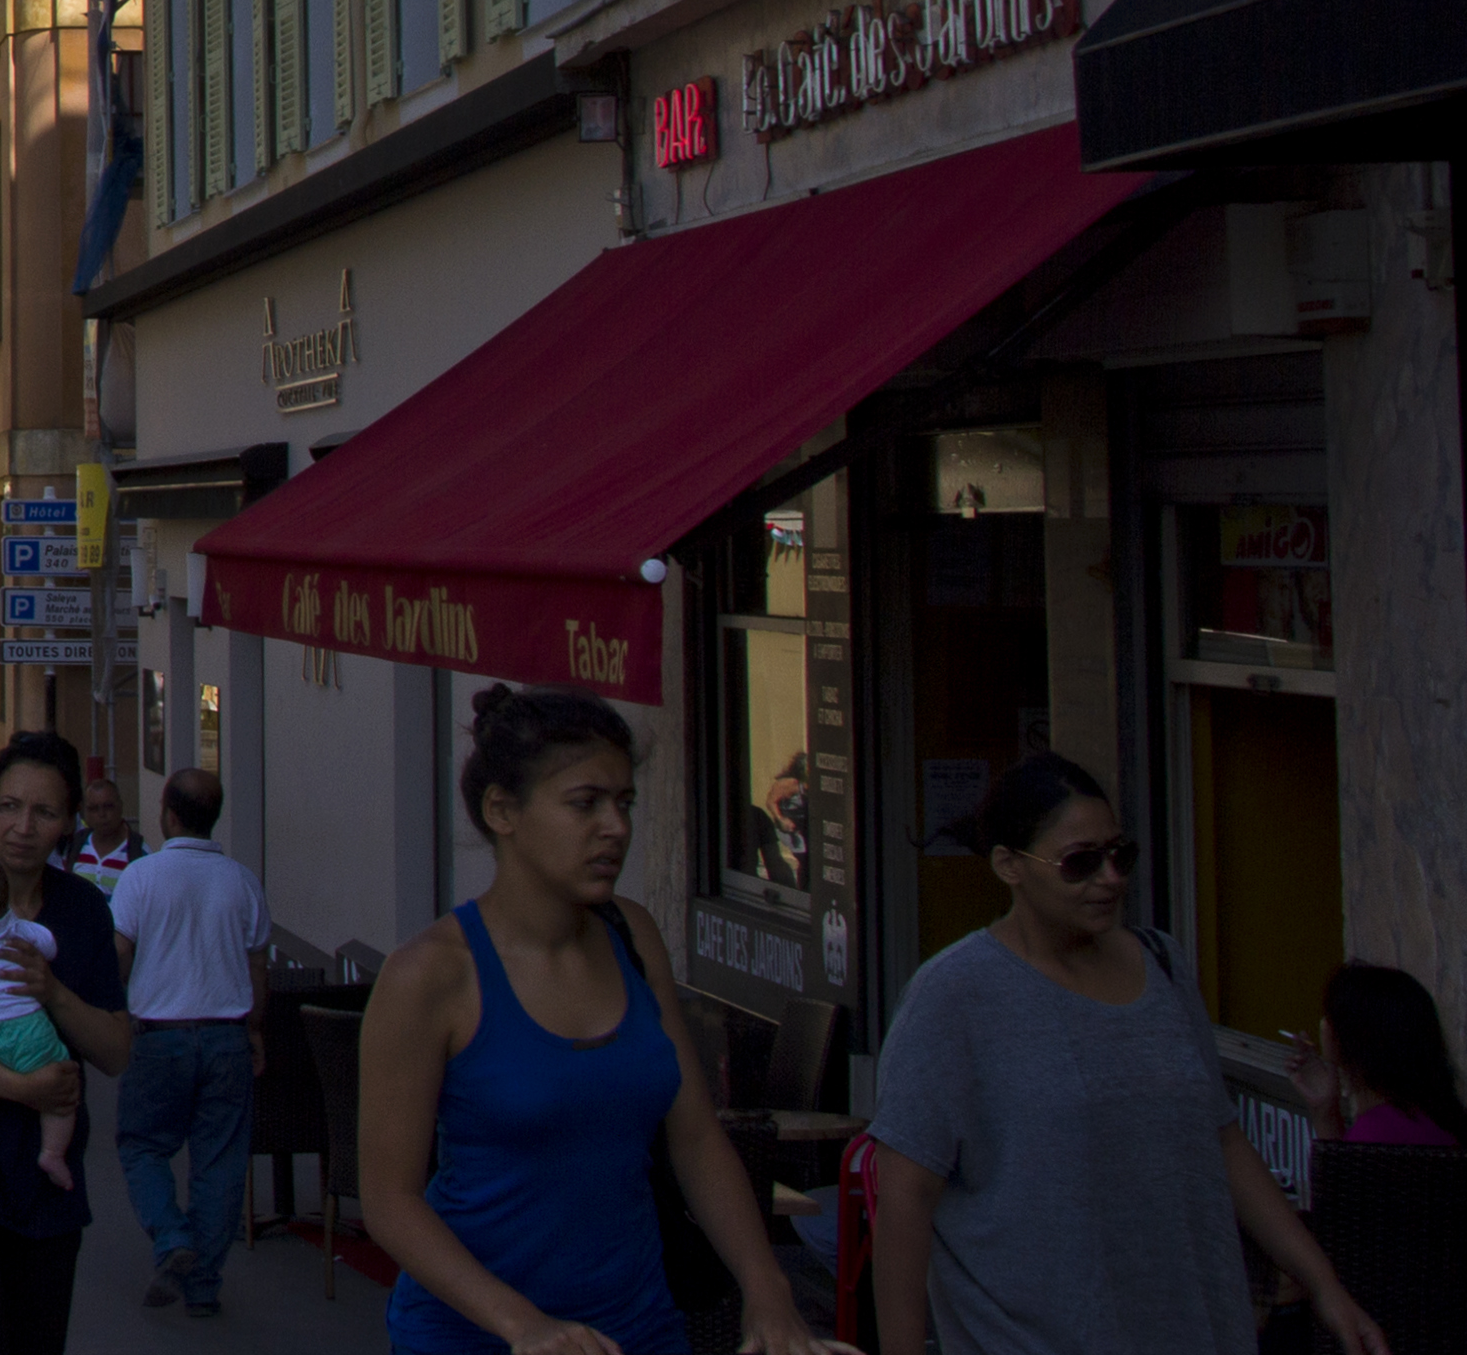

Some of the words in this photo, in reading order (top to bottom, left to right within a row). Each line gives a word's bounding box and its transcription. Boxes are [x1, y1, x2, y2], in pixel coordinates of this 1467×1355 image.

[777, 10, 848, 128] Café
[850, 4, 911, 94] des
[654, 80, 715, 169] BAR
[28, 505, 67, 518] Hôtel
[44, 544, 78, 556] Palais
[45, 558, 69, 568] 340
[45, 593, 77, 605] Saleya
[44, 604, 80, 614] Marché
[281, 571, 322, 637] Café
[333, 579, 369, 646] des
[382, 583, 480, 665] Jardins
[7, 646, 59, 658] TOUTES
[565, 617, 628, 686] Tabac
[725, 919, 749, 973] DES
[751, 929, 804, 993] JARDINS
